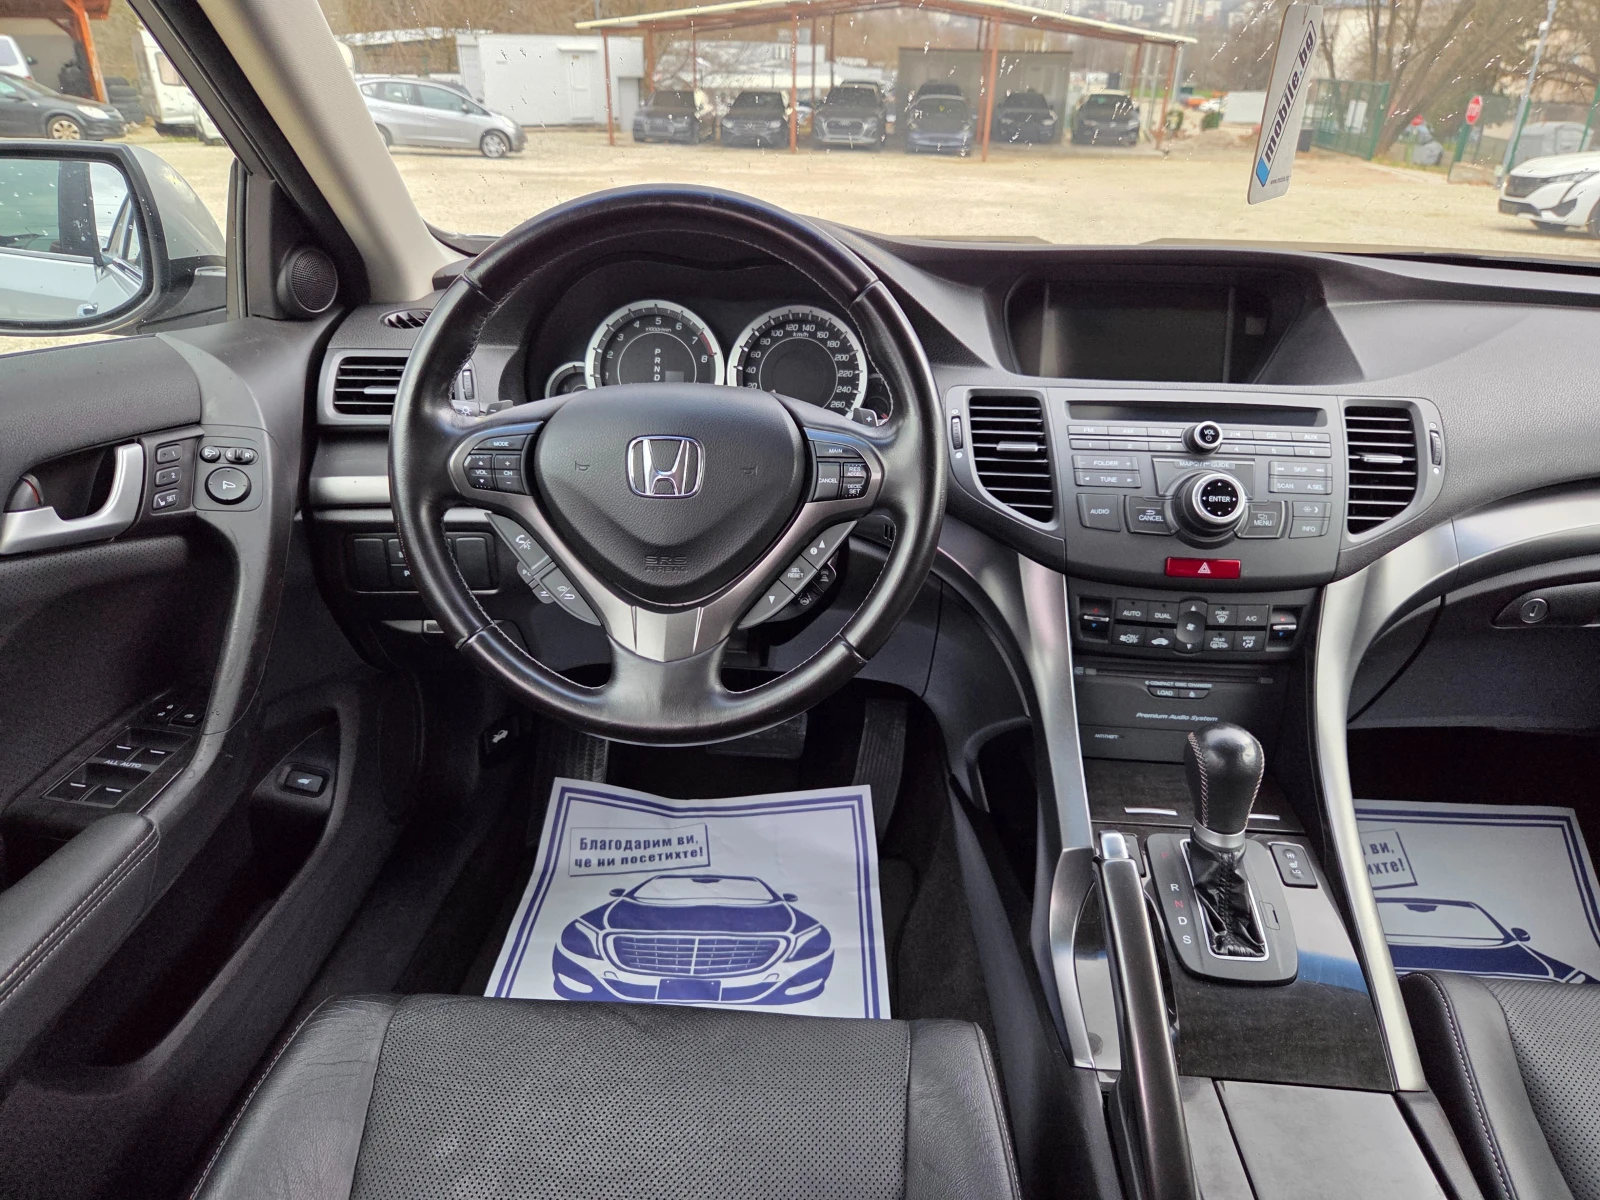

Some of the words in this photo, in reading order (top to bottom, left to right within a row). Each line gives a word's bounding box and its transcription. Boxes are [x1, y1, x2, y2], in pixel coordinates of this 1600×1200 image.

[1264, 30, 1315, 163] mobile.bg
[633, 320, 640, 329] 4
[655, 316, 662, 325] 5
[675, 322, 683, 330] 6
[785, 323, 799, 331] 120
[802, 323, 816, 332] 140
[616, 333, 624, 341] 3
[771, 329, 784, 337] 100
[816, 331, 829, 339] 160
[691, 336, 698, 345] 7
[826, 340, 841, 348] 180
[606, 350, 614, 359] 2
[750, 350, 761, 358] 60
[834, 353, 850, 361] 200
[654, 356, 661, 364] R
[700, 355, 708, 363] 8
[653, 365, 661, 373] N
[653, 374, 661, 382] D
[838, 370, 853, 378] 220
[747, 382, 758, 390] 20
[836, 386, 852, 394] 240
[830, 401, 846, 409] 260
[166, 494, 176, 502] SET
[1208, 495, 1231, 503] ENTER
[1138, 514, 1164, 522] CANCEL
[1253, 519, 1273, 527] MENU
[644, 555, 688, 565] SRS
[1168, 713, 1190, 721] Audio
[1190, 714, 1218, 722] System
[104, 758, 119, 767] ALL
[120, 760, 142, 769] AUTO
[579, 836, 673, 852] Благодарим
[676, 834, 699, 847] ви,
[1369, 842, 1395, 855] ви,
[574, 857, 592, 869] че
[597, 856, 616, 868] ни
[620, 846, 704, 866] посетихте!
[1367, 857, 1406, 876] ихте!
[1170, 883, 1180, 892] R
[1174, 900, 1184, 908] N
[1177, 916, 1188, 925] D
[1182, 935, 1192, 944] S
